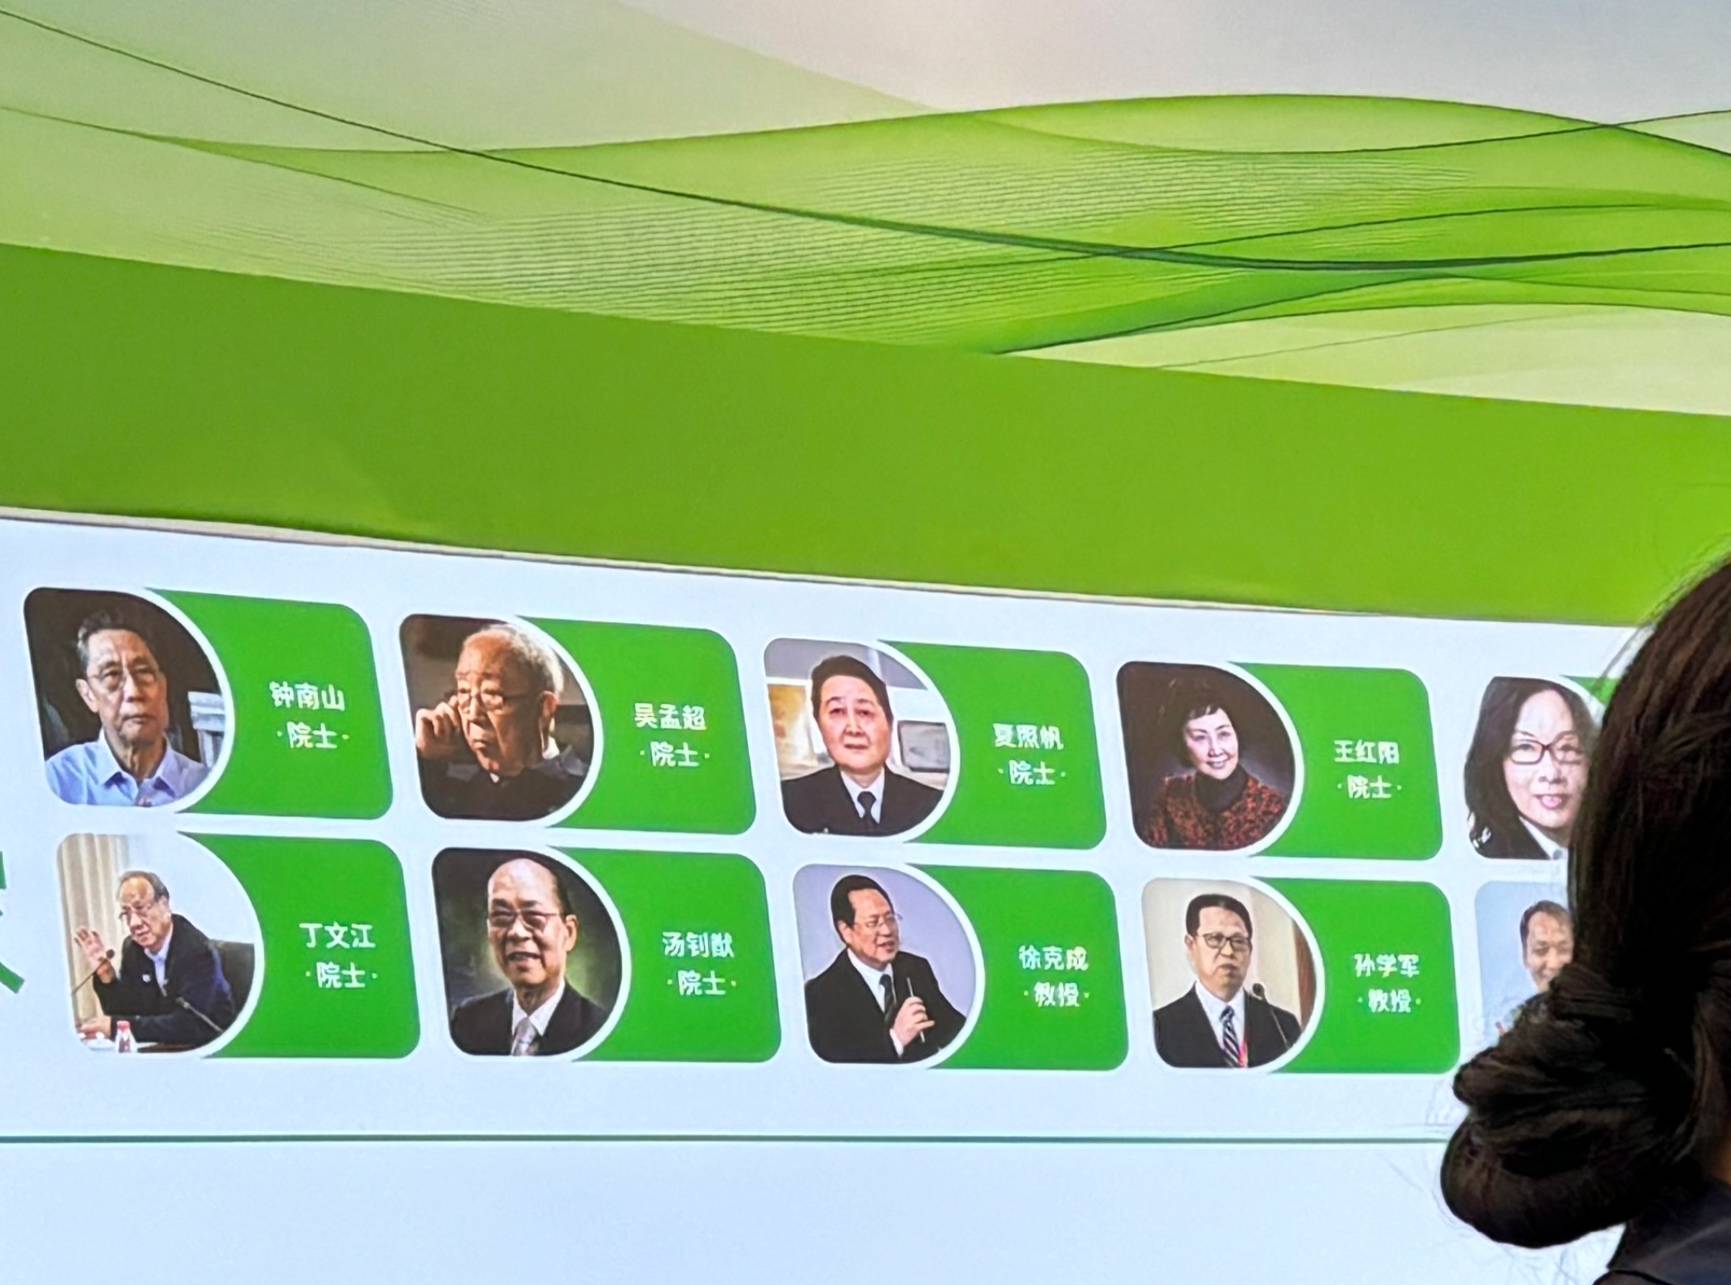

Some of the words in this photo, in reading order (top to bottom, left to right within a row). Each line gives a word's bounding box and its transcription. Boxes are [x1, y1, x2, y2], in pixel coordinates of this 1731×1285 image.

[269, 681, 345, 711] 钟南山
[634, 704, 706, 731] 吴孟超
[993, 724, 1064, 750] 夏照帆
[1334, 740, 1400, 765] 王红阳
[299, 922, 375, 950] 丁文江
[1018, 946, 1089, 972] 徐克成
[1354, 953, 1419, 978] 孙学军
